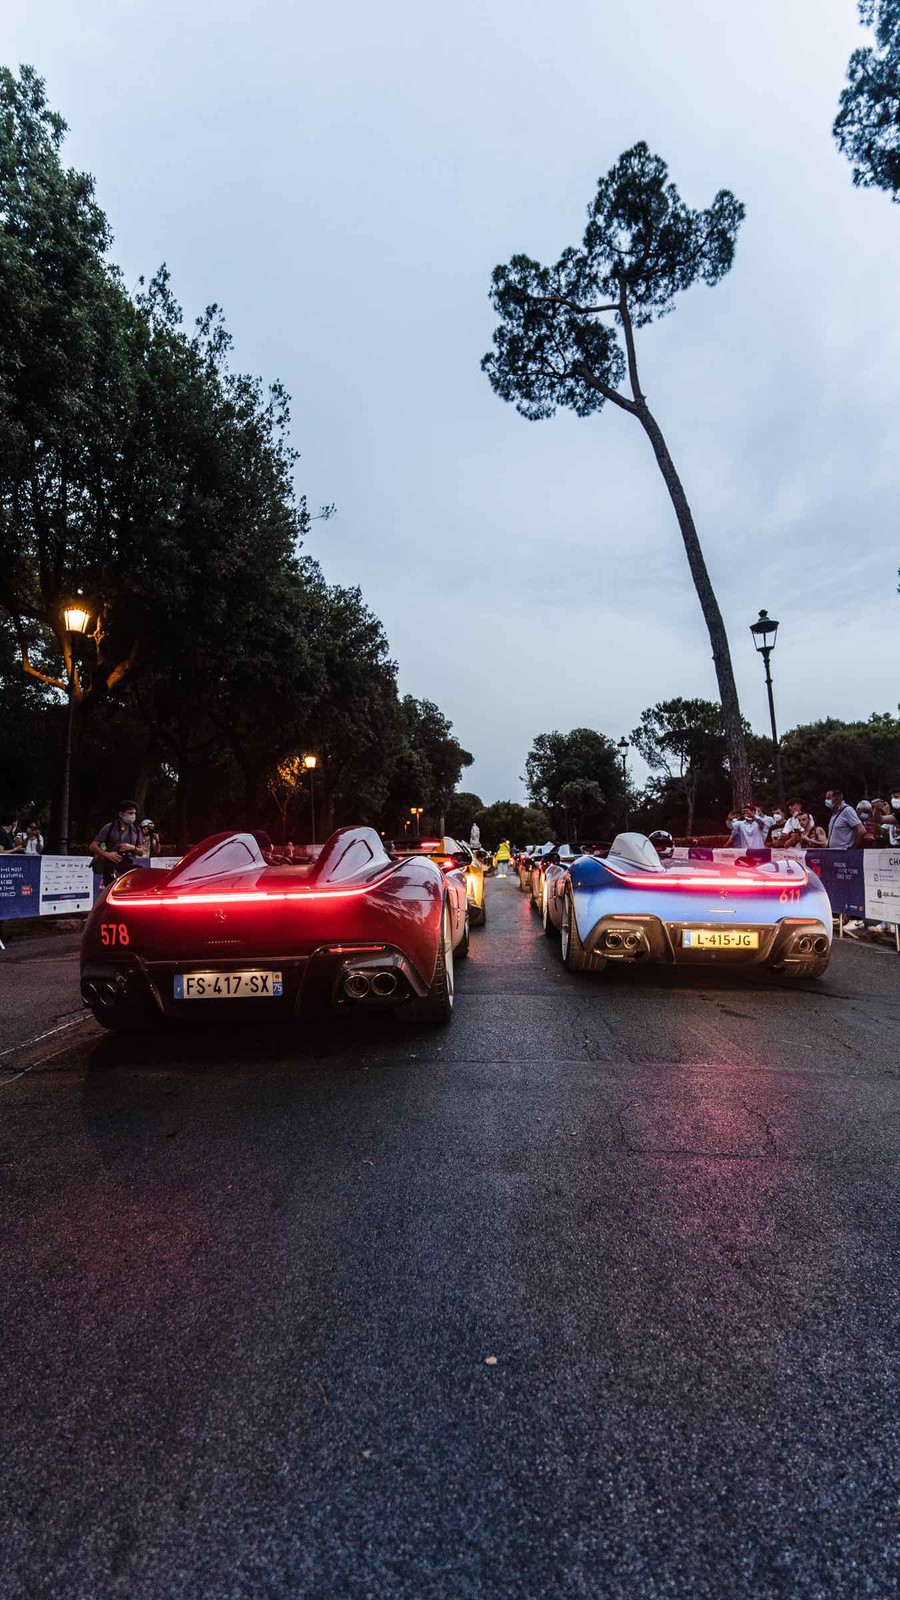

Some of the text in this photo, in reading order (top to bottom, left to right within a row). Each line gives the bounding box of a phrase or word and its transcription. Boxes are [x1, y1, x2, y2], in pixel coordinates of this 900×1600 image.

[780, 888, 801, 904] 611
[100, 924, 130, 946] 578
[697, 934, 751, 946] L-415-JG
[186, 975, 270, 996] FS-417-SX
[273, 983, 283, 992] 75
